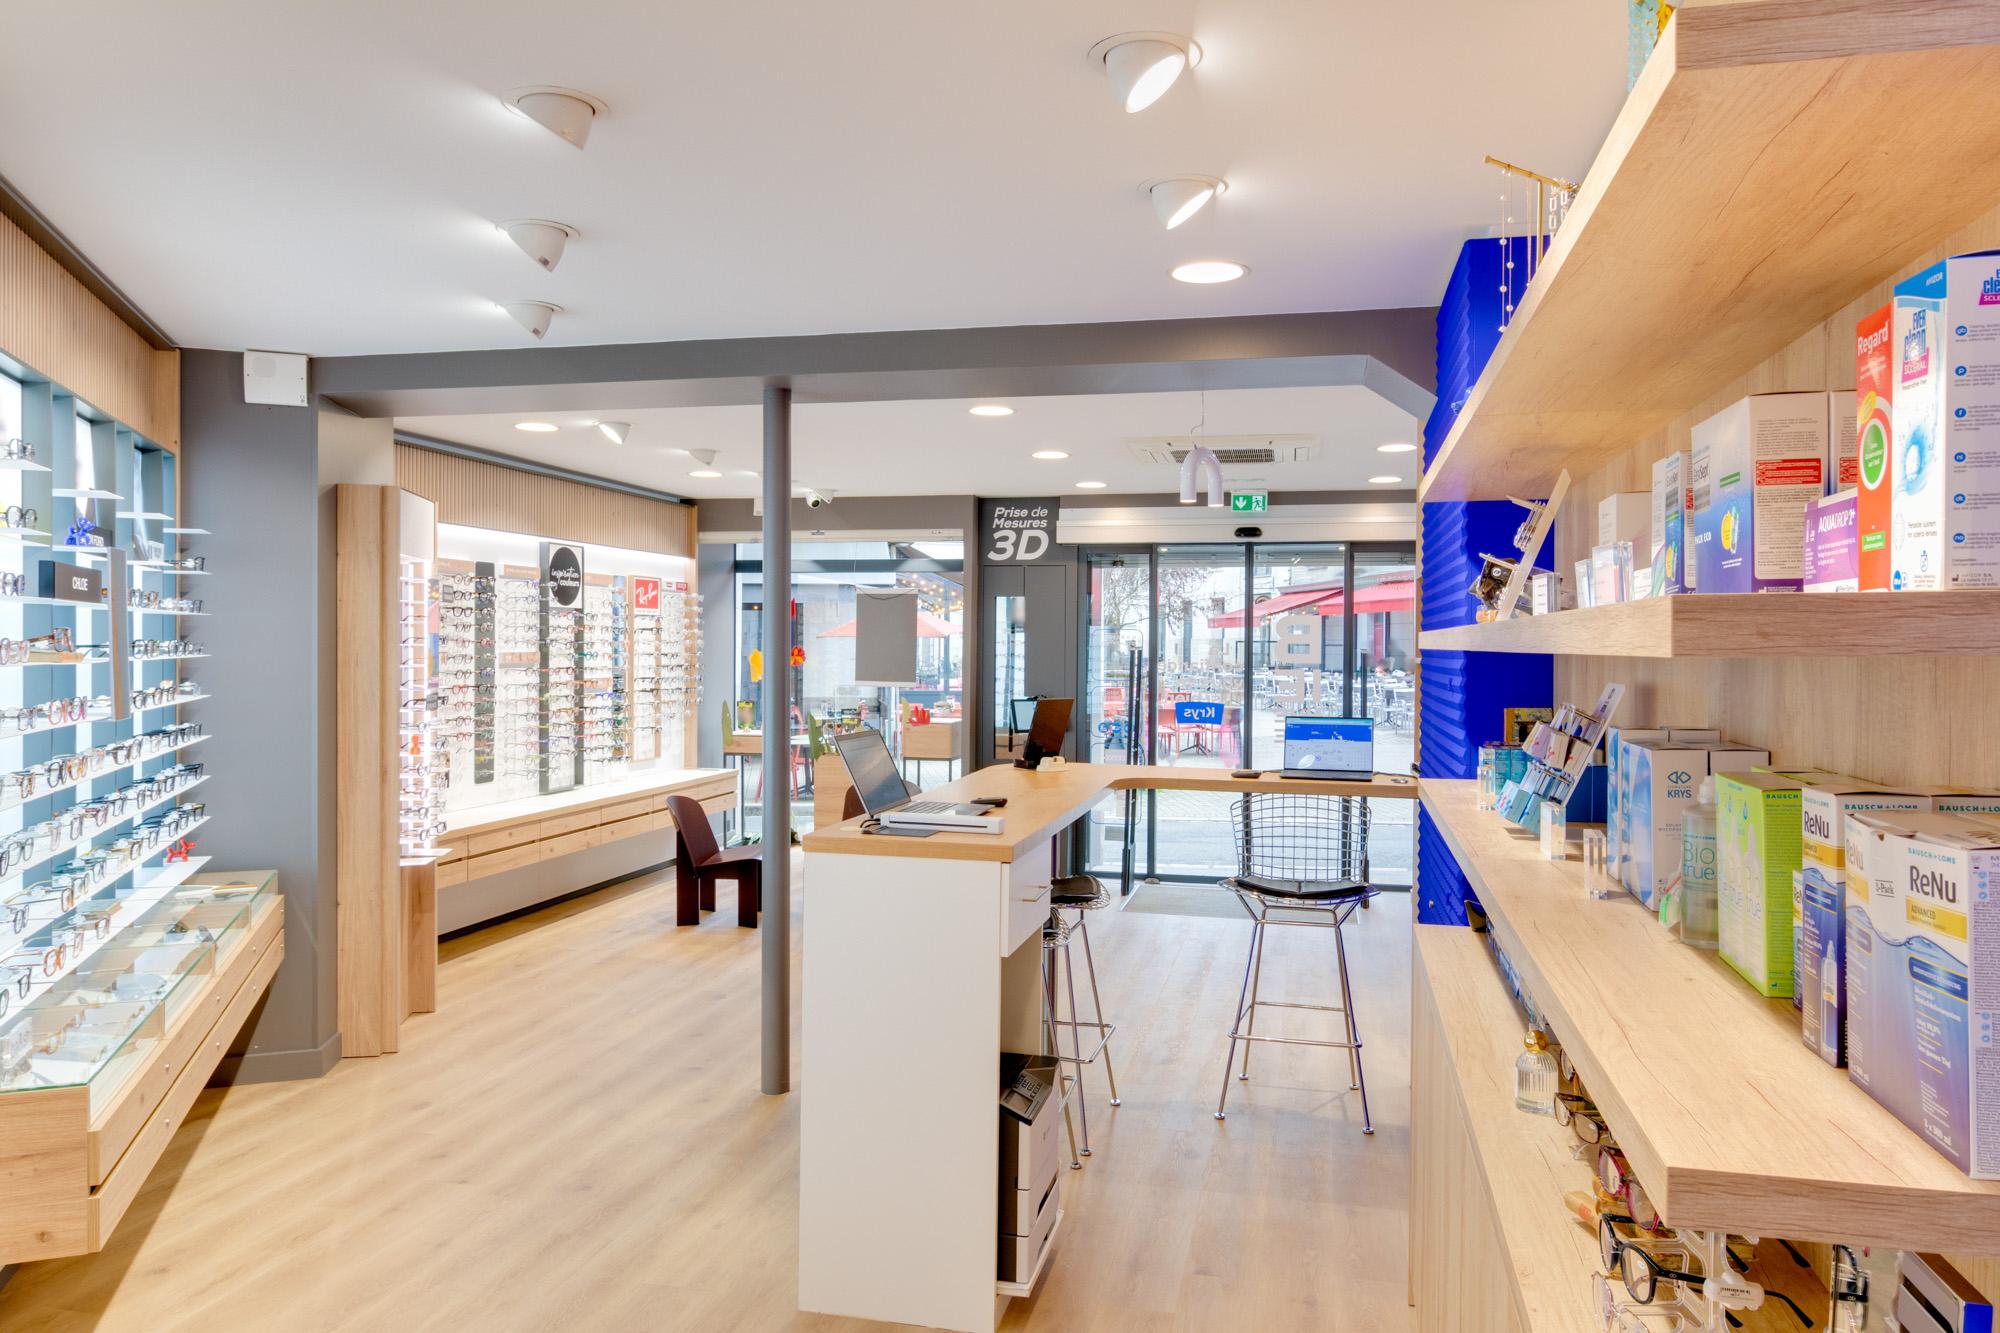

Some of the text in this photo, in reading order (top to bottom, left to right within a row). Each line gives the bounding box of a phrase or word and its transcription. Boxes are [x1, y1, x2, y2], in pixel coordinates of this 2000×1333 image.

[1857, 322, 1888, 356] Regard
[994, 507, 1048, 518] Prise de
[992, 518, 1048, 528] Mesures
[987, 529, 1049, 561] 3D
[1703, 531, 1711, 543] ECO
[1667, 789, 1692, 799] KRYS
[1804, 811, 1829, 839] ReNu
[1683, 862, 1716, 880] true
[1910, 865, 1957, 903] ReNu
